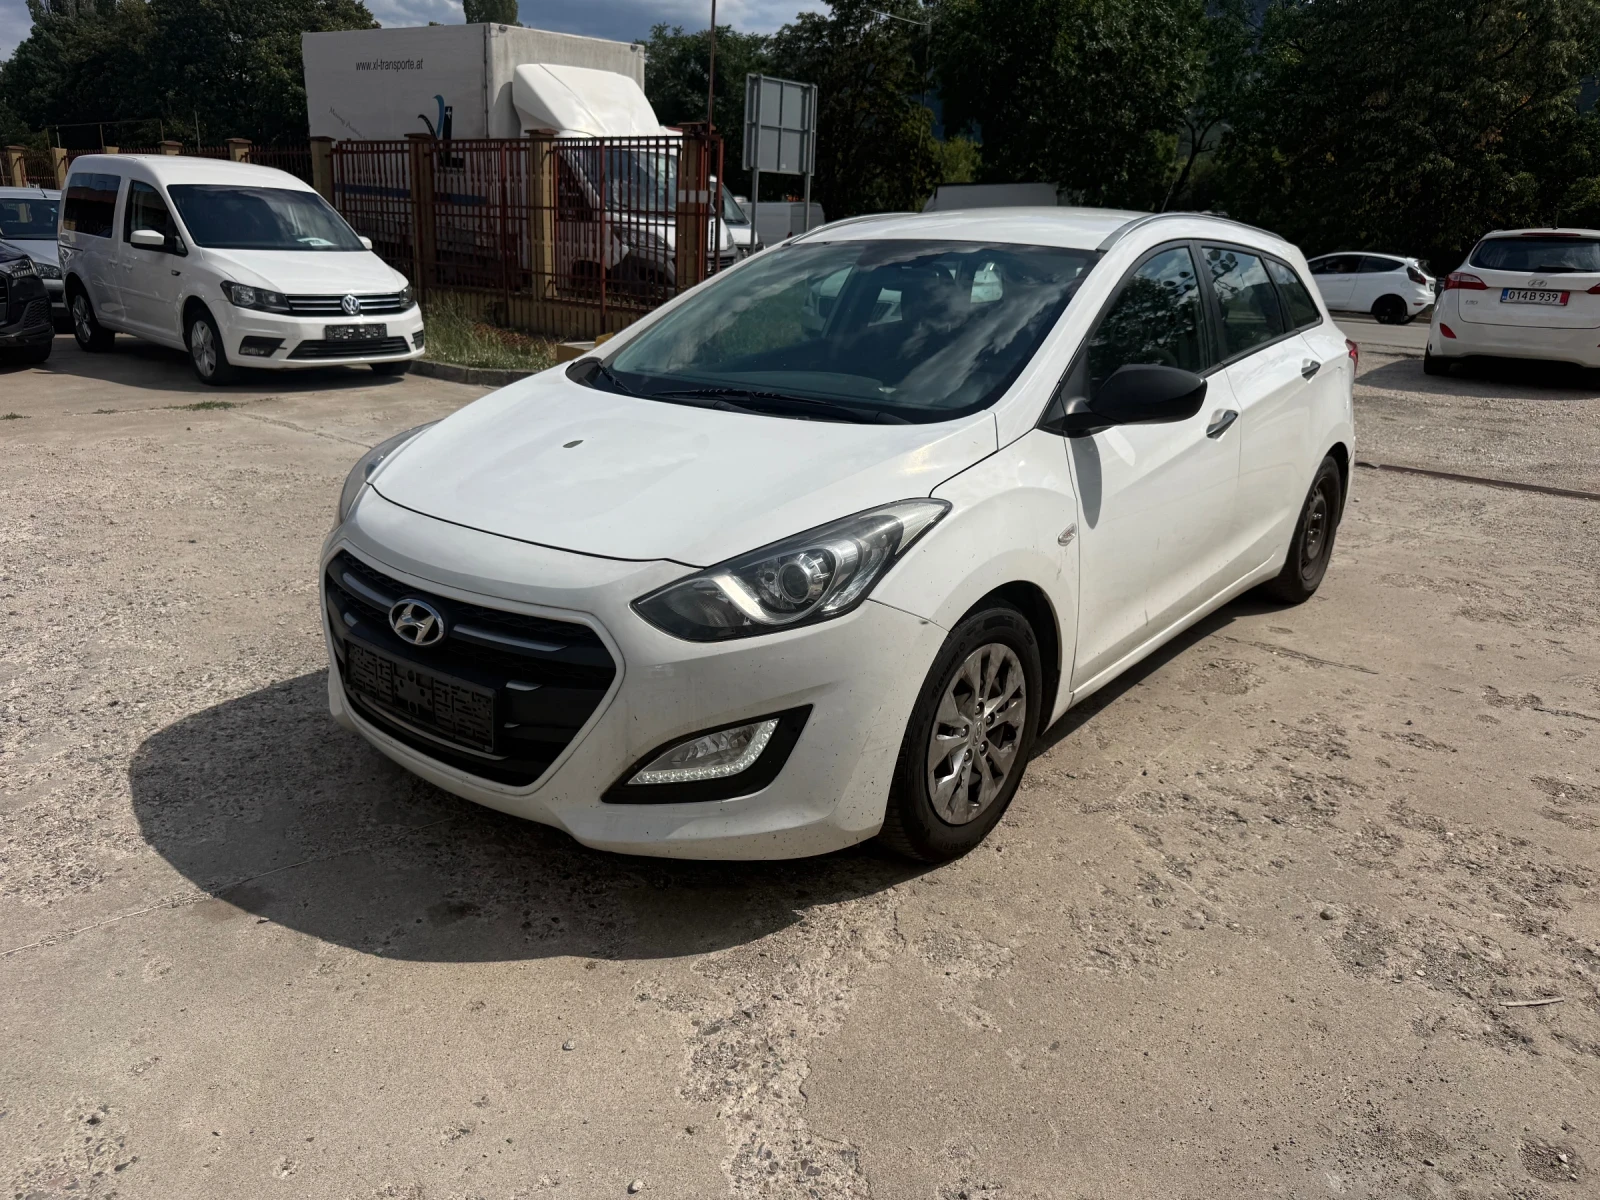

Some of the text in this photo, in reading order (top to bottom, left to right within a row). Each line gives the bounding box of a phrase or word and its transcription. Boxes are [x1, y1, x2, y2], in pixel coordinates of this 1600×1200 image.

[356, 58, 423, 72] www.xl-transporte.at
[1508, 291, 1537, 301] 014B
[1538, 292, 1558, 302] 939
